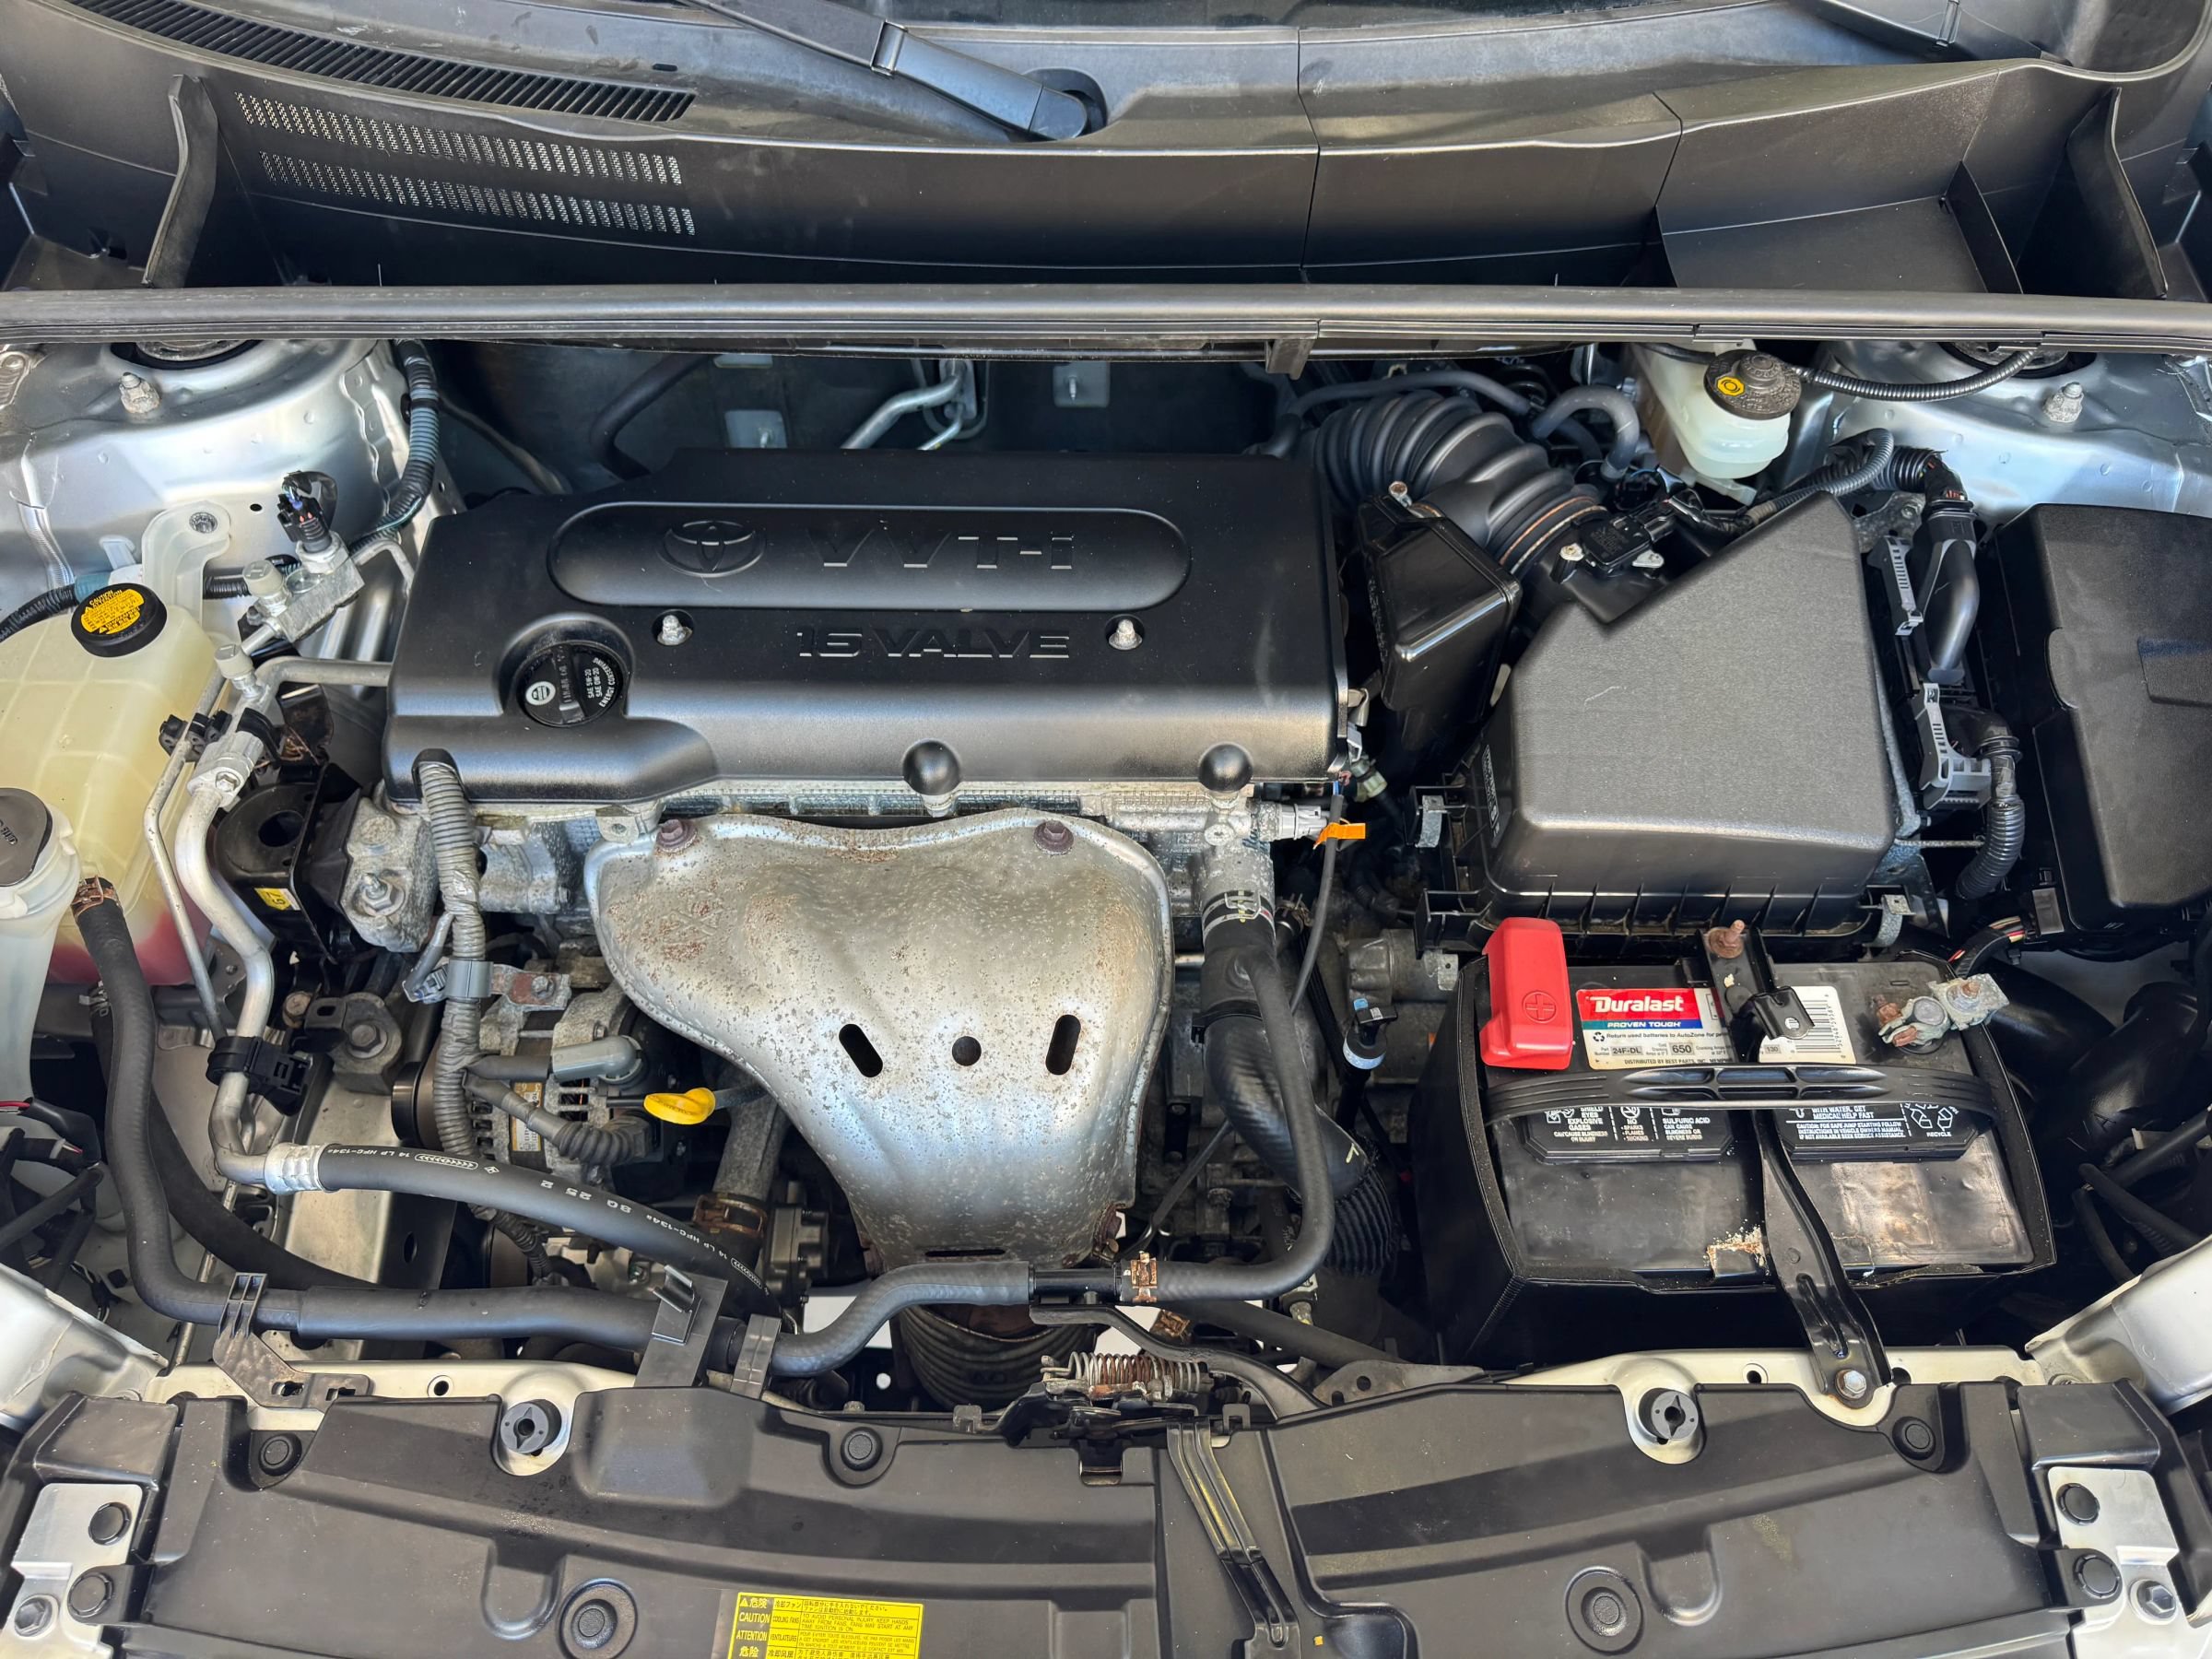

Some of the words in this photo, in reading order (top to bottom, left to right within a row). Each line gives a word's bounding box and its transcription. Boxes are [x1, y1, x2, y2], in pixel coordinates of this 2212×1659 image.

[796, 629, 863, 657] 16
[874, 629, 1070, 658] VALVE
[592, 657, 616, 686] CONSERVING
[592, 667, 601, 686] 0W-20
[584, 669, 594, 686] 5W-20
[586, 687, 594, 699] SAE
[594, 686, 603, 697] SAE
[599, 687, 615, 708] ENERGY
[1590, 995, 1684, 1013] Duralast
[540, 1180, 553, 1189] 2
[566, 1187, 592, 1200] 25
[703, 1242, 715, 1252] LP
[719, 1250, 727, 1260] 14
[750, 1598, 767, 1608] 危険
[739, 1612, 771, 1623] CAUTION
[736, 1630, 768, 1641] ATTENTION
[739, 1646, 759, 1657] 危险
